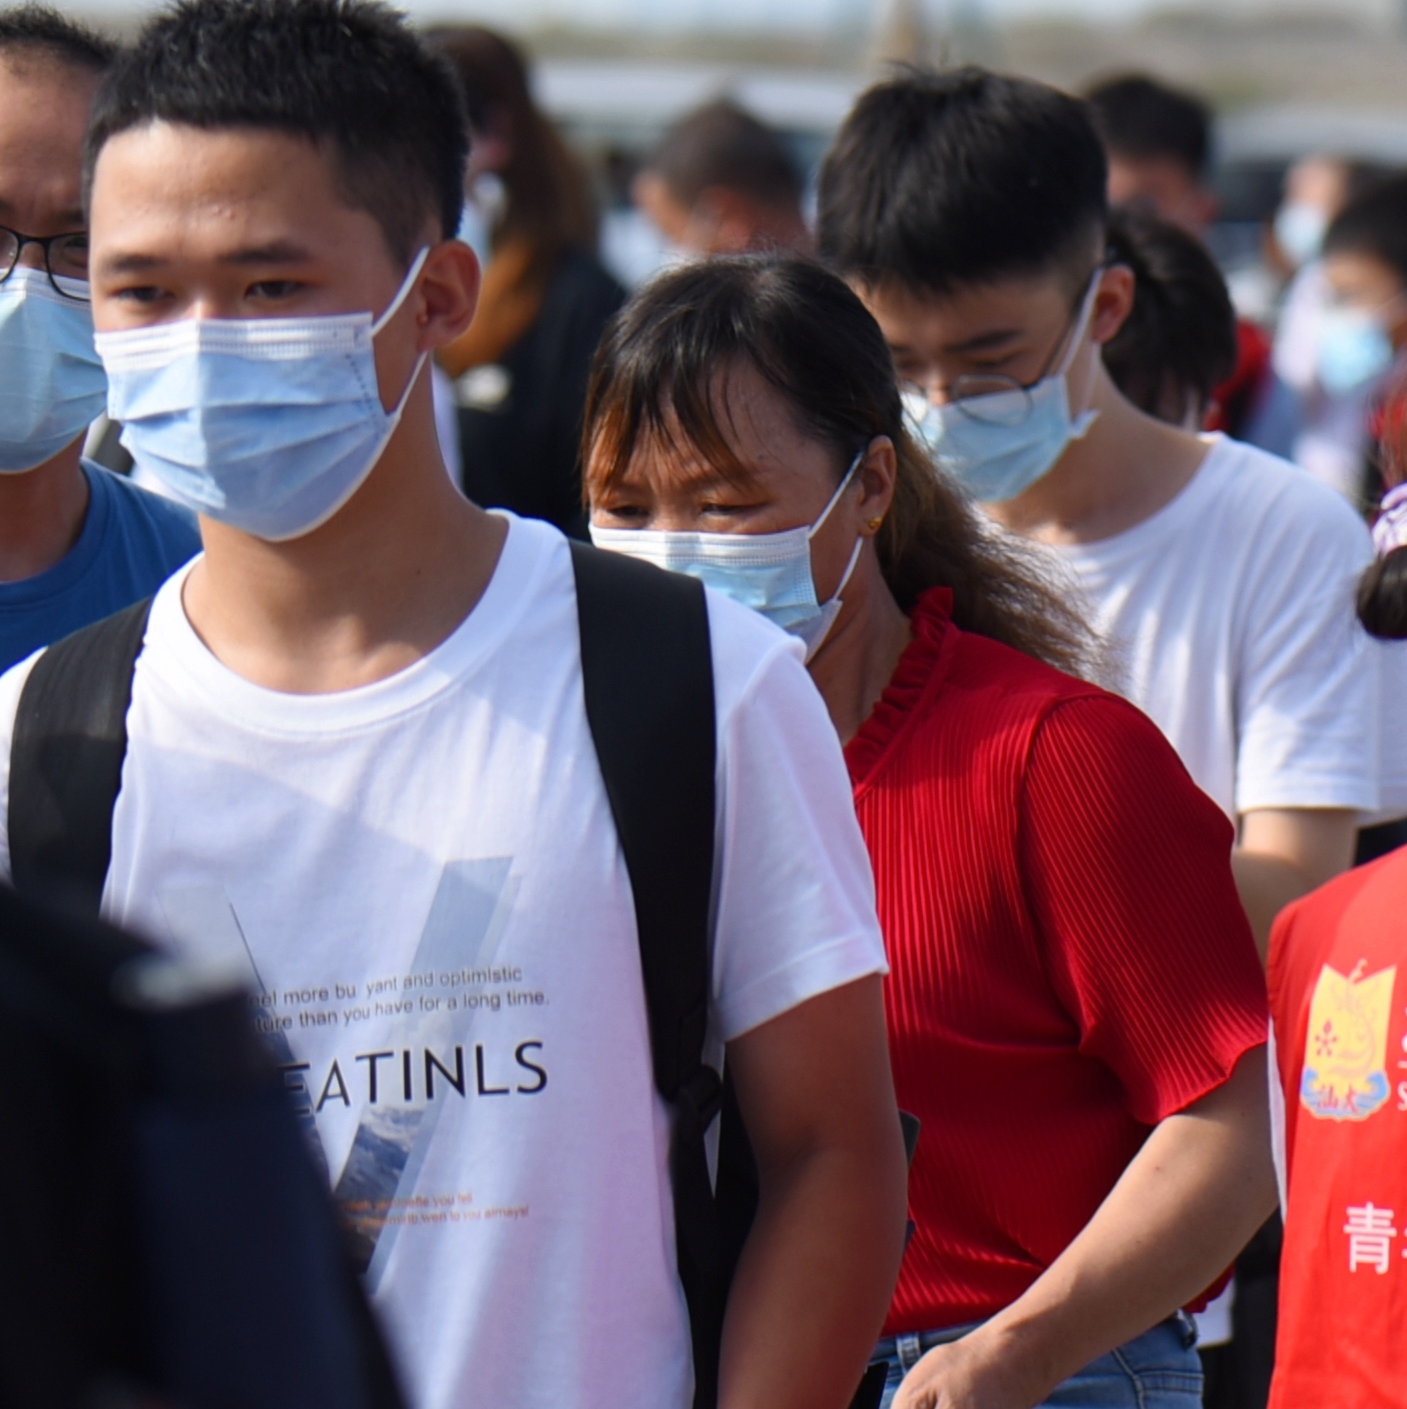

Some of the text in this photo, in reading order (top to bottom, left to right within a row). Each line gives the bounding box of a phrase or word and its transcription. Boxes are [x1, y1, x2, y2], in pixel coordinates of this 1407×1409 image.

[284, 988, 329, 1006] more
[335, 983, 357, 1000] bu
[403, 970, 434, 989] and
[299, 1010, 338, 1028] than
[344, 1006, 370, 1027] you
[375, 1000, 413, 1016] have
[419, 995, 441, 1011] for
[447, 997, 457, 1010] a
[463, 993, 501, 1012] long
